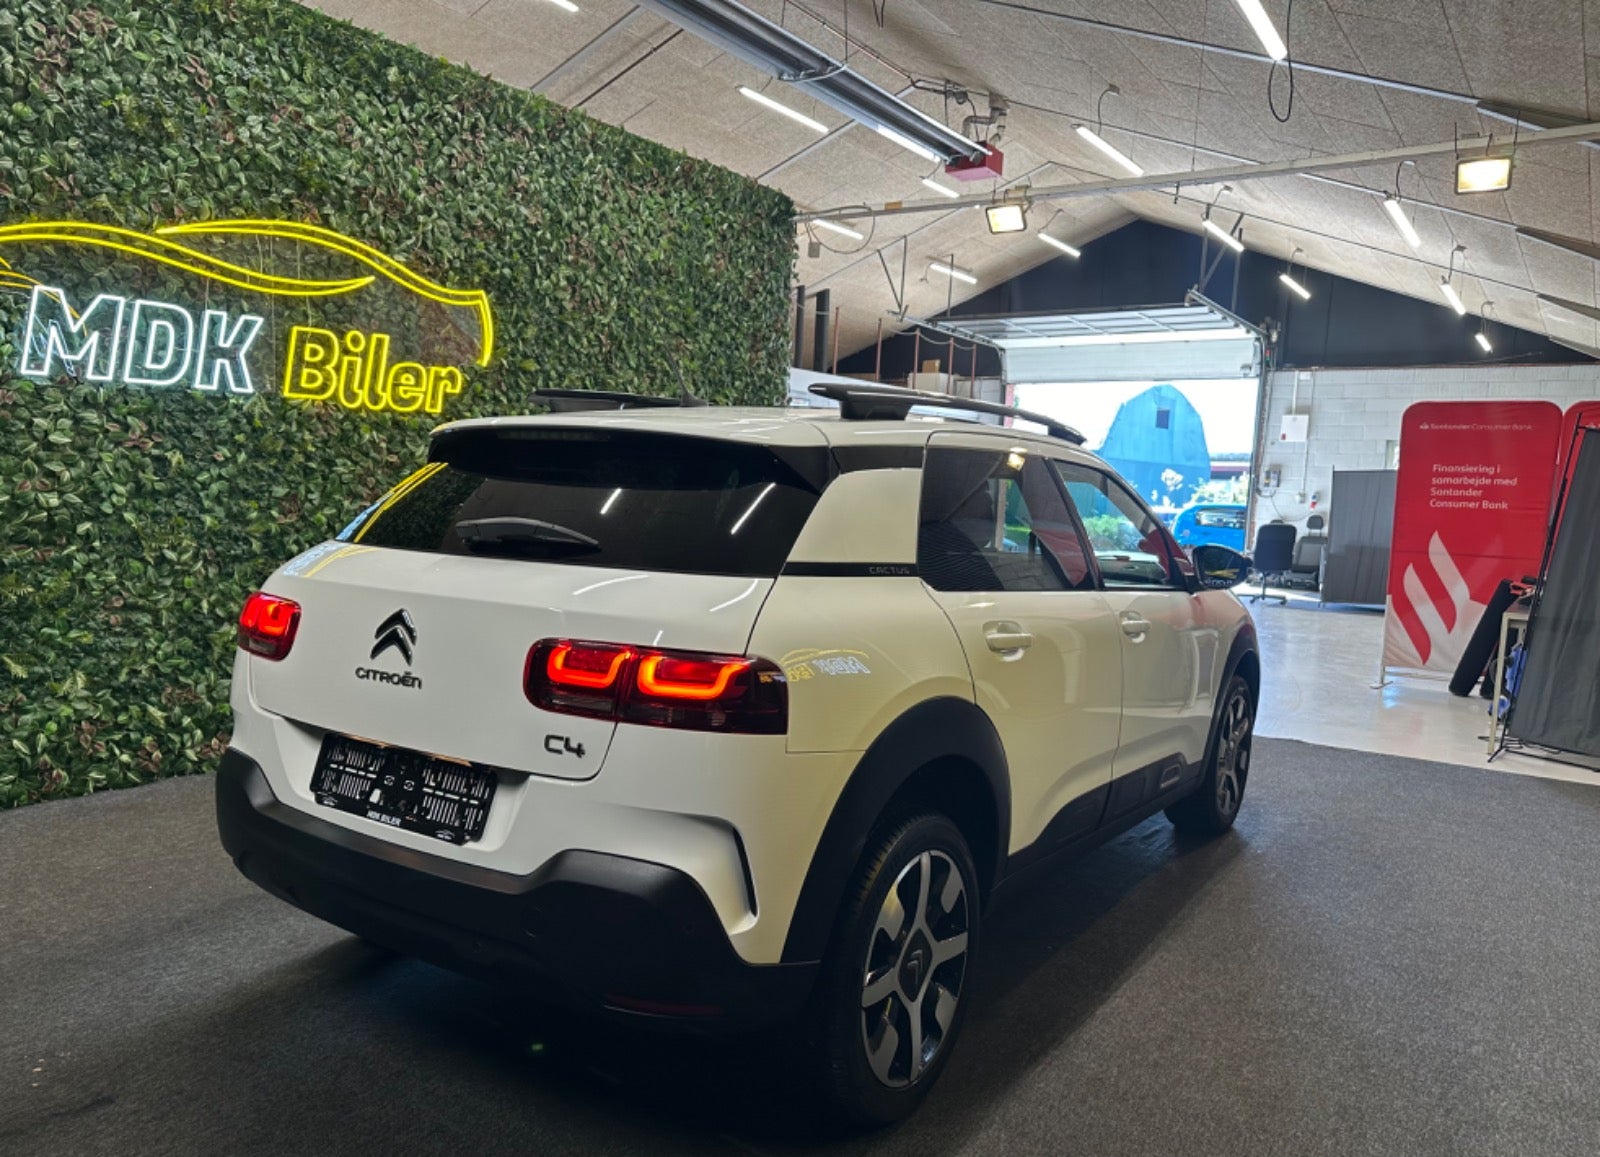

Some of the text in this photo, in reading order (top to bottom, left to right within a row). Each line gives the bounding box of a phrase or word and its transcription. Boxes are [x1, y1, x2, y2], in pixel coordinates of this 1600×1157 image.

[20, 284, 464, 414] MDK Biler
[1432, 463, 1500, 475] Finansiering i
[1431, 476, 1518, 486] samarbejde med
[1430, 487, 1483, 497] Santander
[1429, 499, 1509, 510] Consumer Bank
[544, 734, 586, 759] C4
